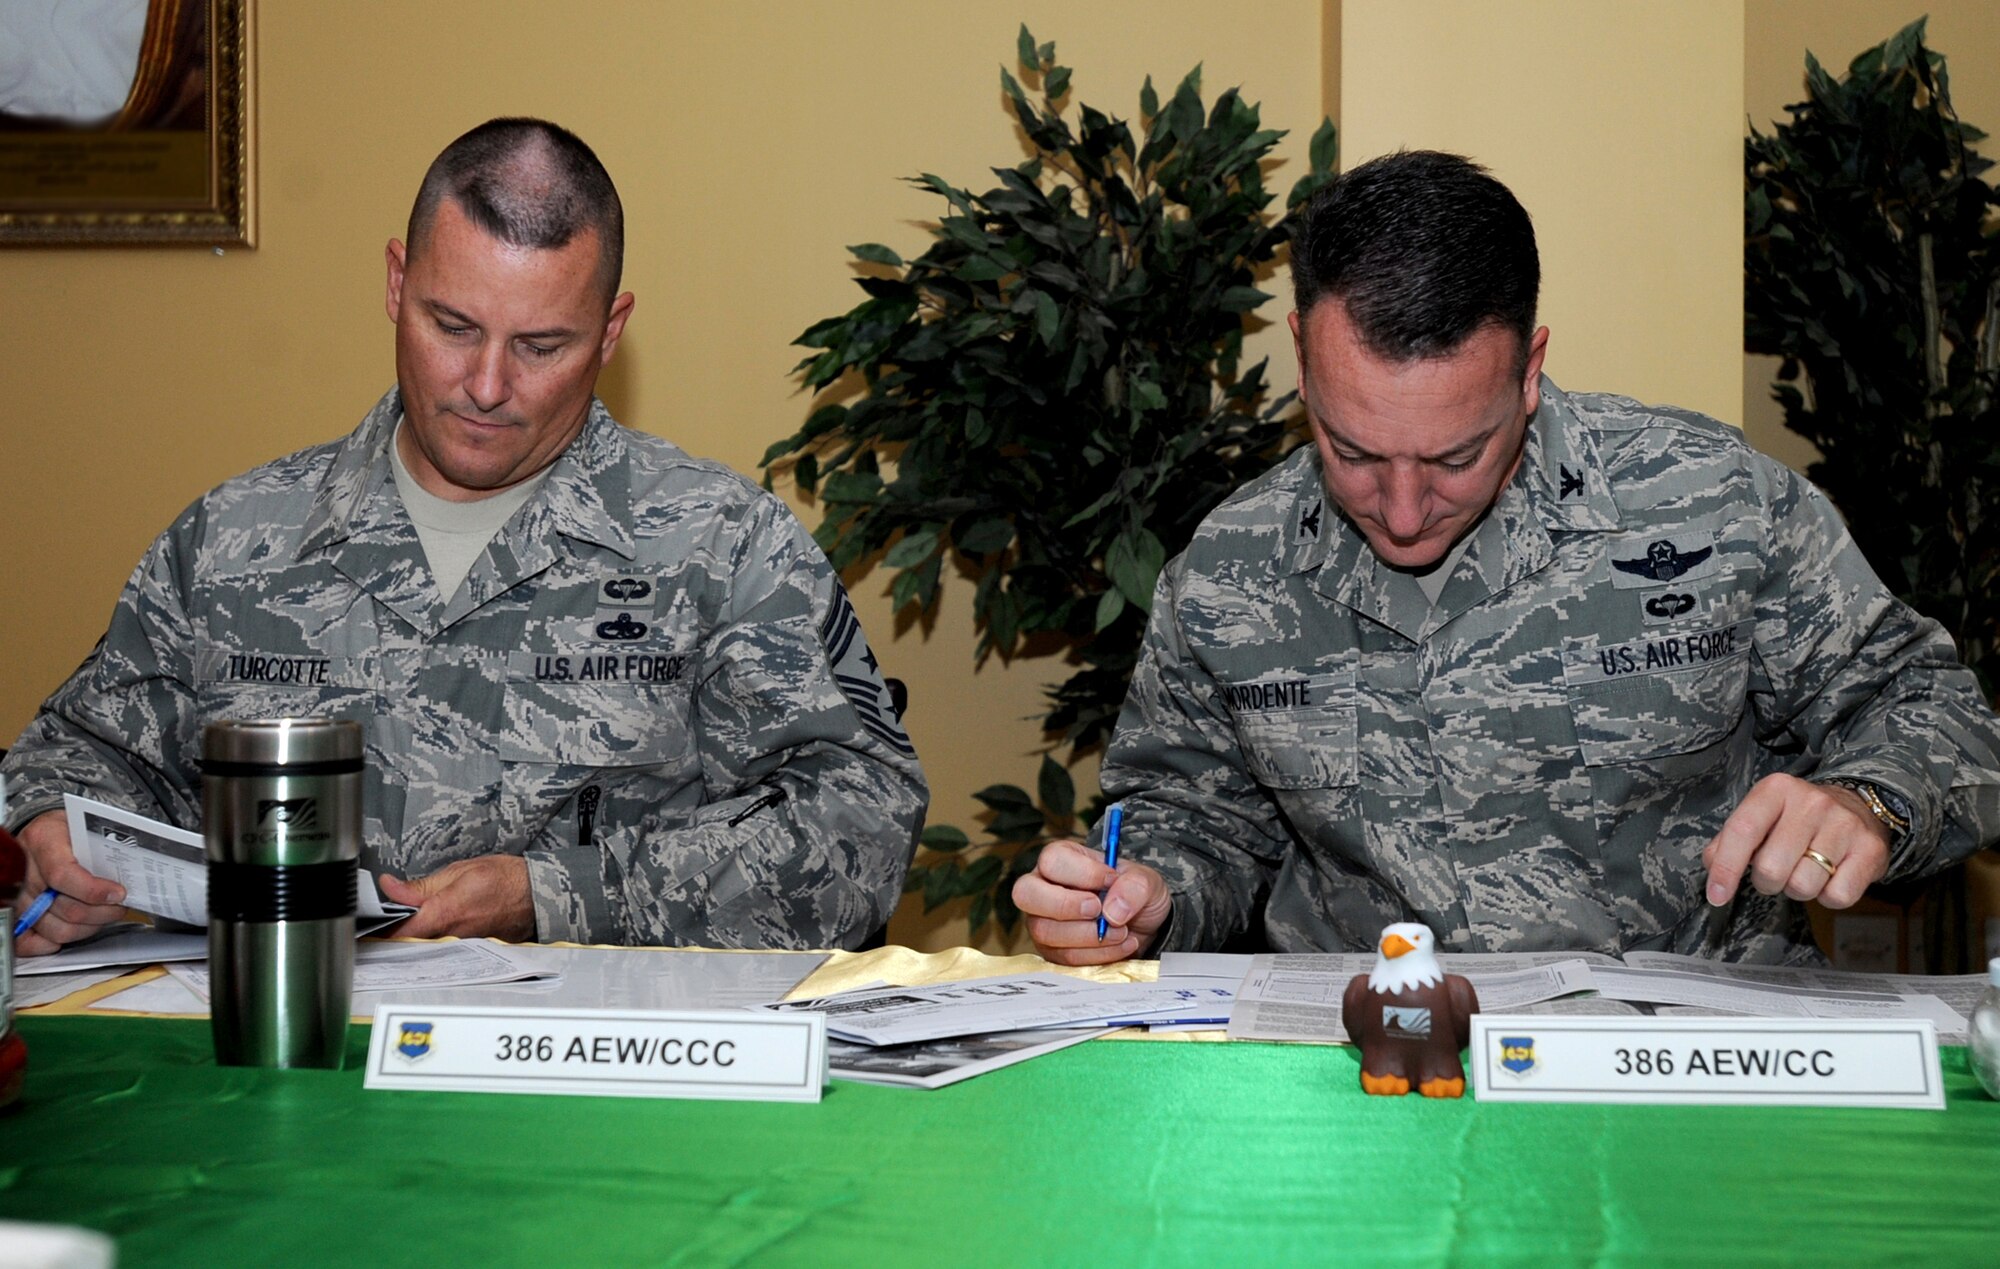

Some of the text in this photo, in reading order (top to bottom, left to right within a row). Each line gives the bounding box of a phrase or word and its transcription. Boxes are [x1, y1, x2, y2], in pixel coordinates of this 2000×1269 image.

[1600, 626, 1738, 676] U.S. AIR FORCE
[228, 654, 331, 684] TURCOTTE
[535, 654, 686, 682] U.S. AIR FORCE
[494, 1034, 737, 1067] 386 AEW/CCC
[1614, 1048, 1836, 1077] 386 AEW/CC
